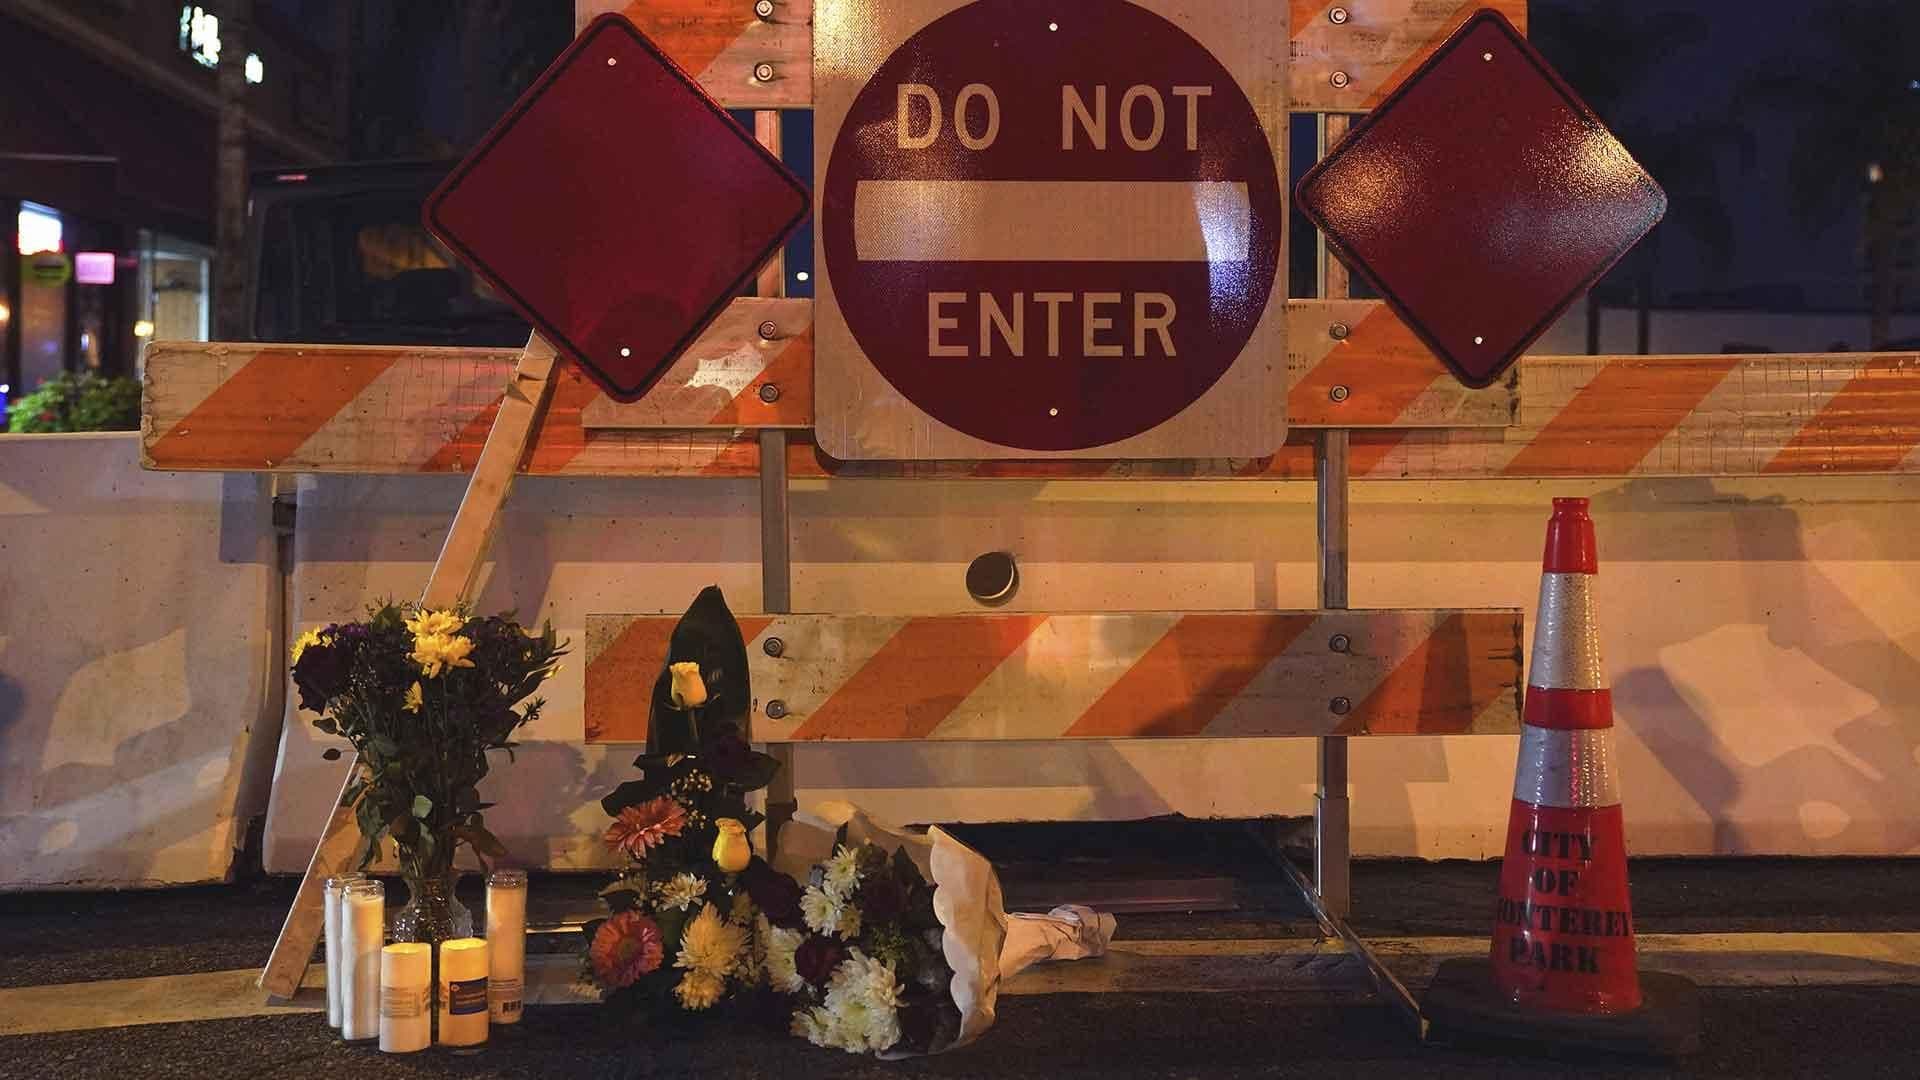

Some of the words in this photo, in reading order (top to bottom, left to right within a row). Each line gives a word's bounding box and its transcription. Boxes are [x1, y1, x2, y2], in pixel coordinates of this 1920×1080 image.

[897, 83, 1000, 151] DO
[1061, 85, 1212, 151] NOT
[928, 292, 1177, 357] ENTER
[1522, 831, 1595, 859] CITY
[1535, 866, 1579, 896] OF
[1510, 936, 1600, 974] PARK
